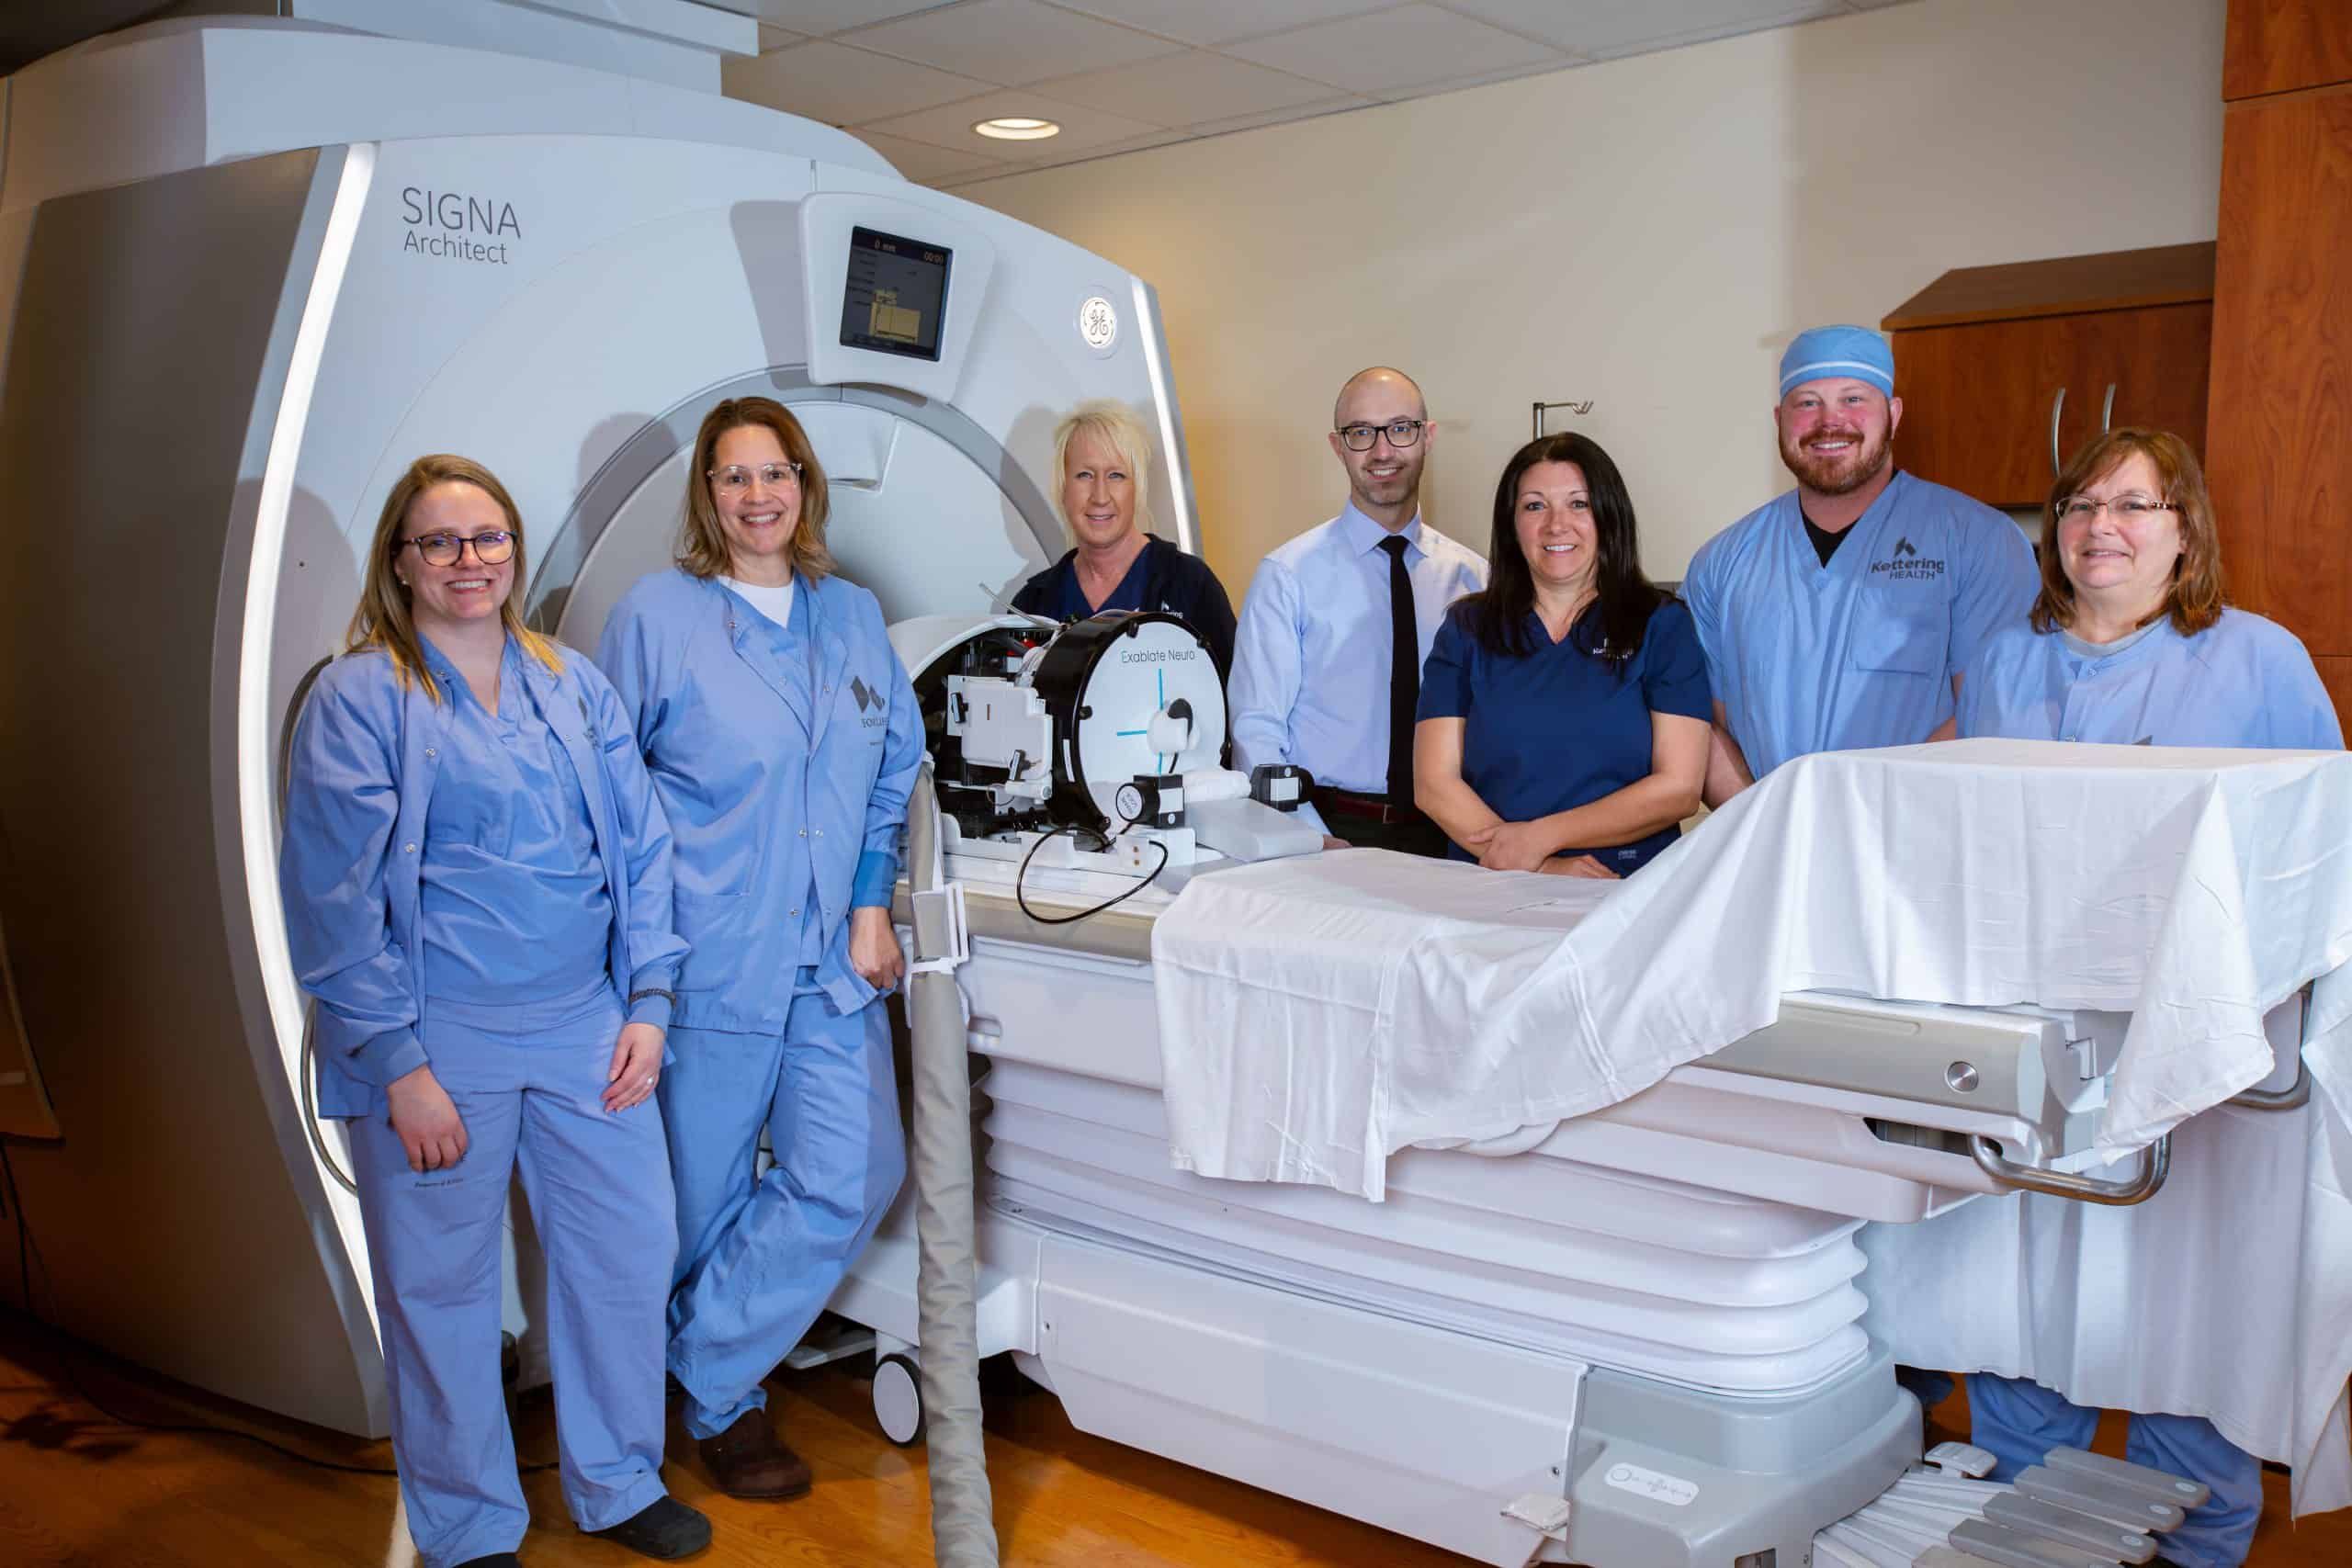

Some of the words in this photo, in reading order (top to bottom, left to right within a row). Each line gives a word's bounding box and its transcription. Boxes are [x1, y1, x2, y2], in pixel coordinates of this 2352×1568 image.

[402, 186, 521, 240] SIGNA
[404, 230, 508, 265] Architect
[1871, 558, 1945, 574] Kettering
[1889, 570, 1936, 581] HEALTH
[1121, 649, 1166, 663] Exablate
[1168, 649, 1195, 662] Neuro
